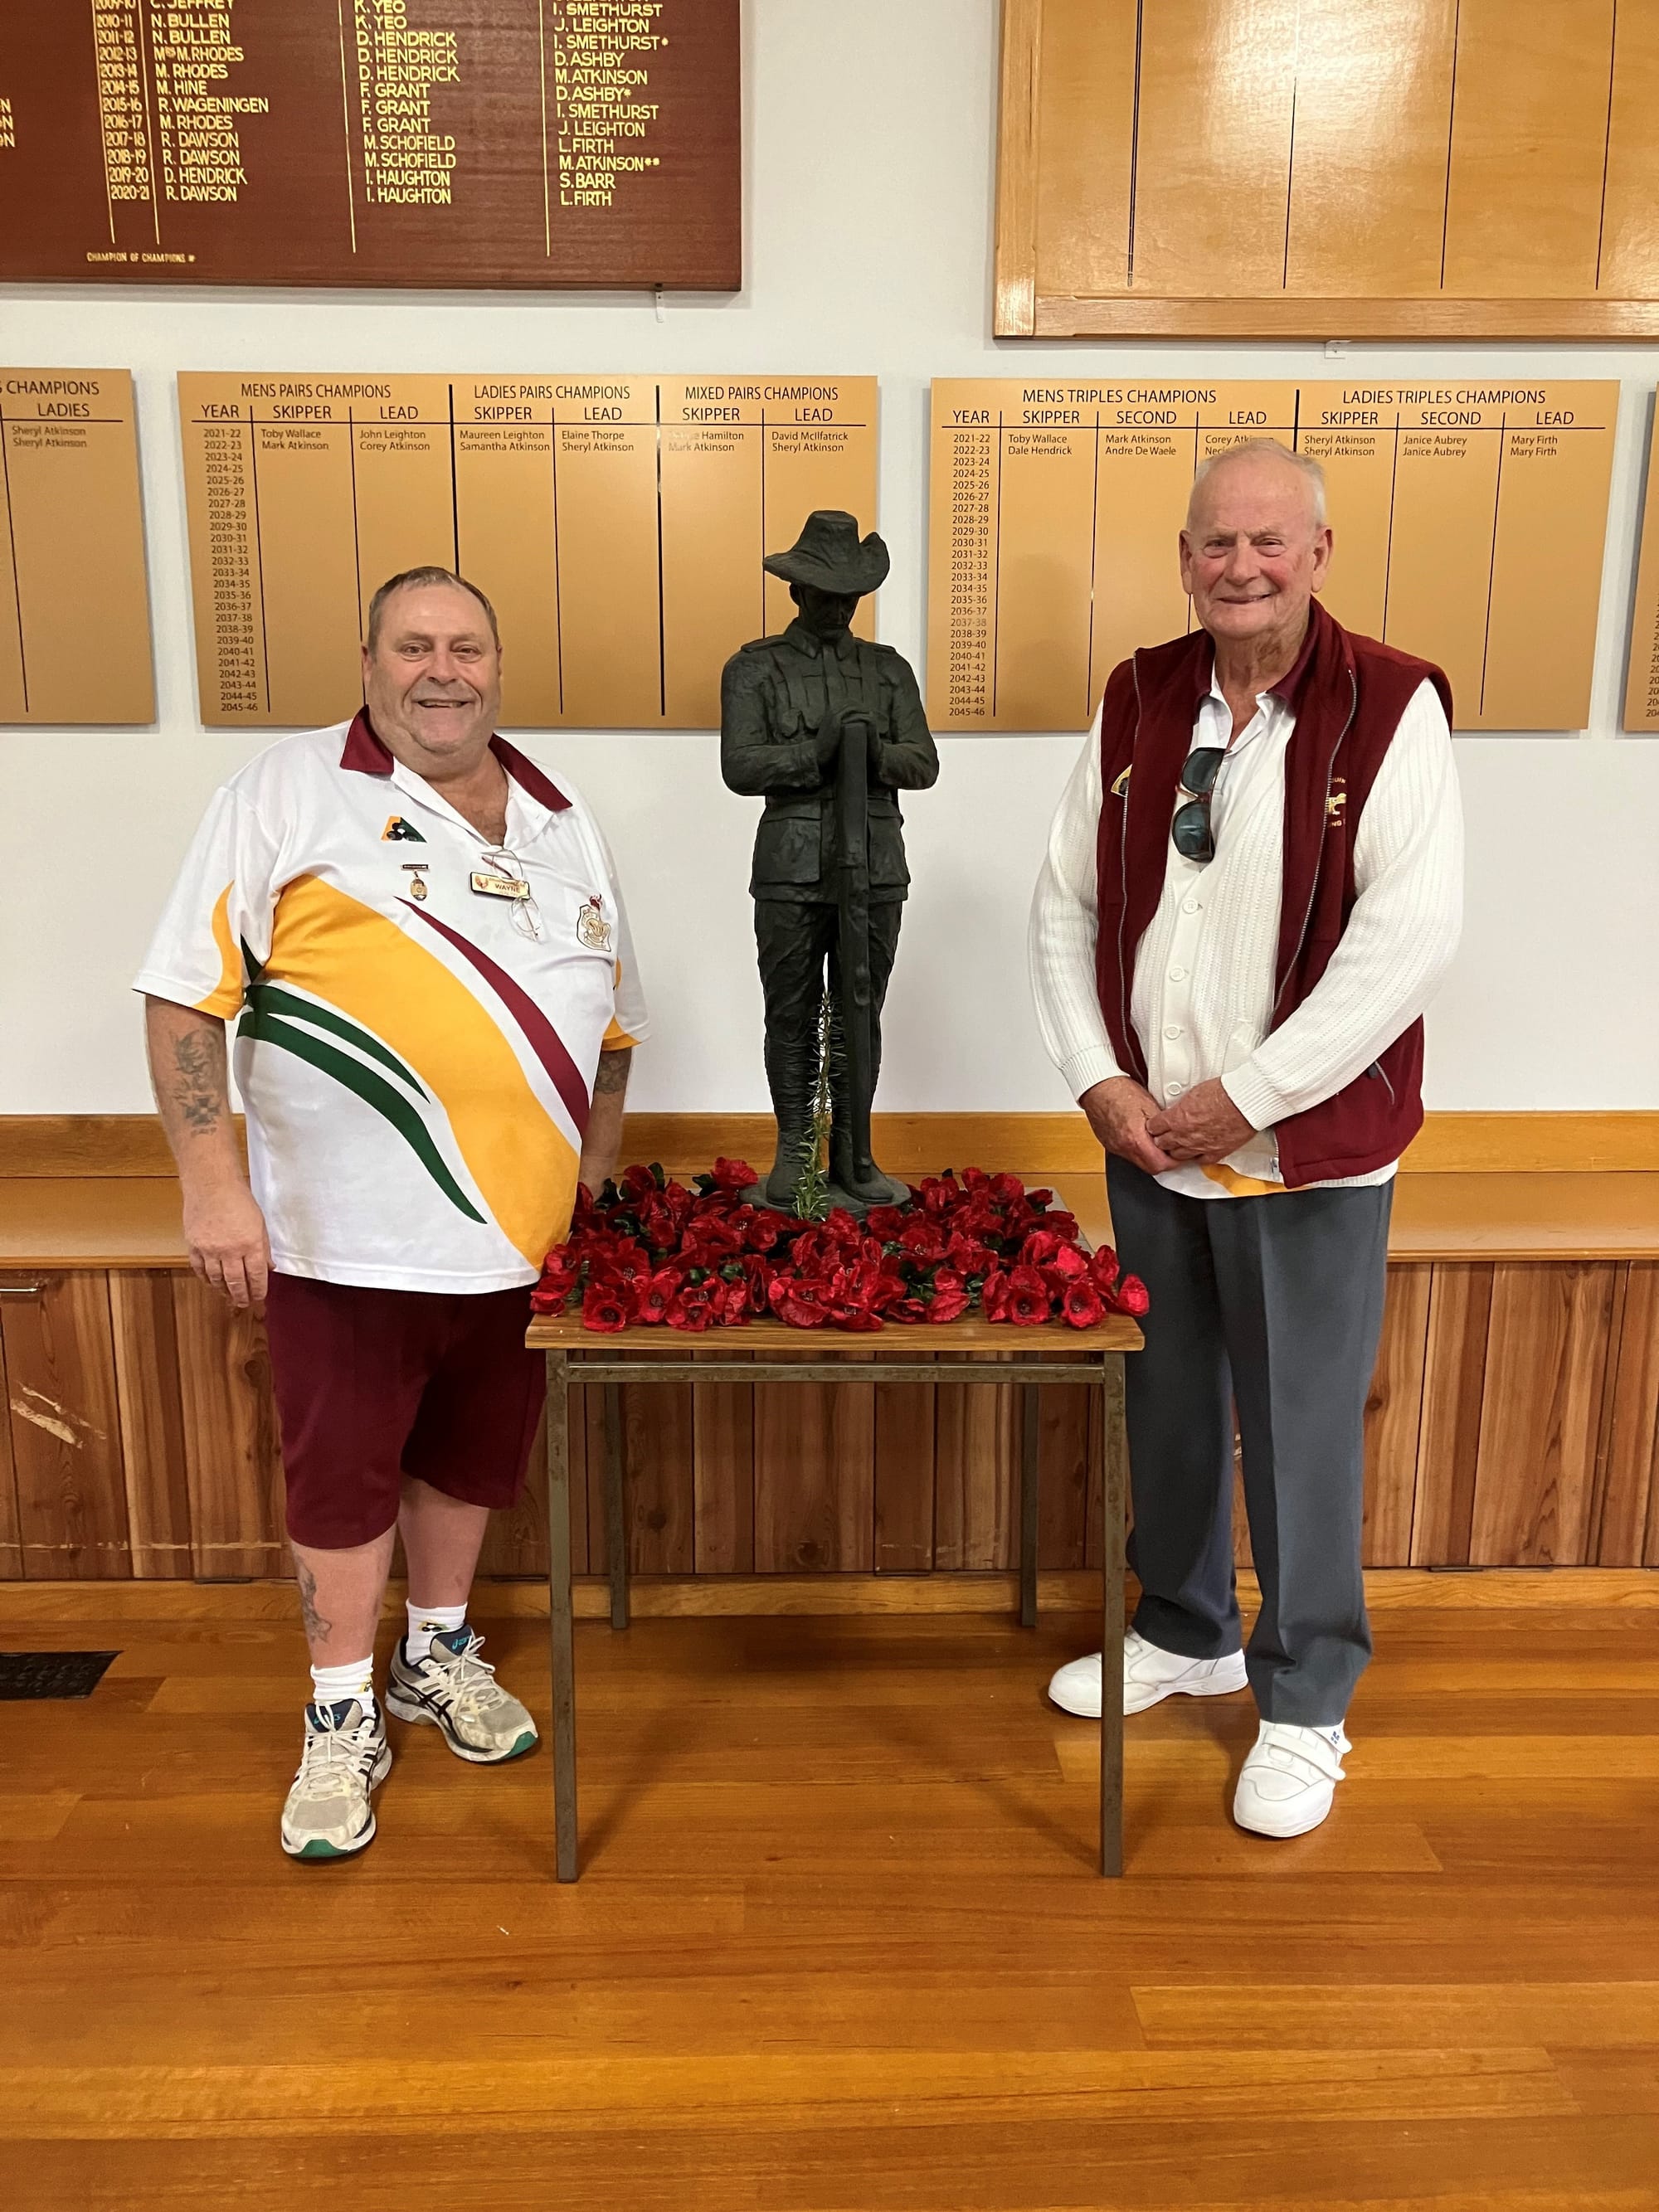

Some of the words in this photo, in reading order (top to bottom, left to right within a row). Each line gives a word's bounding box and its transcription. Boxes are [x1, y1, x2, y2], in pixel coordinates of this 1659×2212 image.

[567, 2, 663, 17] SMETHURST
[373, 15, 406, 29] YEO
[573, 17, 649, 32] LEIGHTON
[376, 48, 458, 64] HENDRICK
[173, 64, 228, 79] RHODES
[377, 66, 460, 81] HENDRICK
[174, 80, 207, 95] HINE
[375, 83, 431, 98] GRANT
[103, 97, 142, 112] 2015-16
[376, 100, 431, 115] GRANT
[569, 104, 659, 119] SMETHURST
[105, 114, 142, 129] 2016-17
[177, 115, 232, 129] RHODES
[377, 118, 431, 133] GRANT
[575, 120, 645, 137] LEIGHTON
[106, 131, 145, 146] 2017-18
[178, 132, 239, 148] DAWSON
[107, 149, 146, 164] 2018-19
[180, 149, 240, 165] DAWSON
[109, 167, 148, 182] 2019-20
[179, 168, 247, 184] HENDRICK
[377, 170, 450, 186] HAUGHTON
[111, 185, 149, 200] 2020-21
[378, 187, 451, 204] HAUGHTON
[87, 252, 127, 261] CHAMPION
[130, 253, 139, 261] OF
[142, 254, 185, 262] CHAMPIONS
[7, 381, 99, 395] CHAMPIONS
[241, 383, 275, 396] MENS
[280, 384, 312, 397] PAIRS
[316, 385, 391, 397] CHAMPIONS
[474, 385, 516, 398] LADIES
[520, 386, 552, 398] PAIRS
[556, 386, 630, 399] CHAMPIONS
[686, 386, 724, 399] MIXED
[729, 387, 761, 400] PAIRS
[765, 387, 838, 400] CHAMPIONS
[1024, 390, 1063, 402] MENS
[1068, 390, 1122, 402] TRIPLES
[1127, 390, 1216, 402] CHAMPIONS
[1344, 391, 1393, 403] LADIES
[1397, 391, 1452, 403] TRIPLES
[1457, 391, 1545, 403] CHAMPIONS
[37, 403, 90, 416] LADIES
[202, 405, 239, 418] YEAR
[274, 406, 331, 418] SKIPPER
[381, 406, 418, 419] LEAD
[474, 406, 532, 420] SKIPPER
[585, 407, 621, 420] LEAD
[683, 408, 739, 421] SKIPPER
[795, 409, 832, 421] LEAD
[953, 411, 989, 423] YEAR
[1023, 411, 1079, 423] SKIPPER
[1117, 411, 1176, 424] SECOND
[1229, 411, 1266, 424] LEAD
[1321, 411, 1378, 425] SKIPPER
[1421, 412, 1481, 425] SECOND
[1537, 411, 1574, 425] LEAD
[12, 425, 41, 437] Sheryl
[45, 426, 85, 435] Atkinson
[204, 429, 241, 438] 2021-22
[261, 429, 283, 440] Toby
[285, 430, 321, 438] Wallace
[360, 430, 377, 438] John
[382, 430, 426, 441] Leighton
[460, 430, 500, 439] Maureen
[504, 431, 544, 441] Leighton
[562, 430, 589, 439] Elaine
[591, 430, 624, 440] Thorpe
[703, 431, 743, 440] Hamilton
[13, 438, 42, 449] Sheryl
[46, 438, 86, 447] Atkinson
[205, 440, 241, 450] 2022-23
[1009, 435, 1030, 445] Toby
[1033, 435, 1067, 443] Wallace
[1106, 435, 1128, 443] Mark
[1131, 435, 1170, 443] Atkinson
[1206, 435, 1232, 445] Corey
[1305, 435, 1332, 445] Sheryl
[1335, 435, 1374, 444] Atkinson
[1434, 435, 1467, 446] Aubrey
[1511, 435, 1535, 446] Mary
[1537, 435, 1557, 444] Firth
[288, 441, 328, 450] Atkinson
[360, 441, 387, 452] Corey
[390, 442, 430, 450] Atkinson
[460, 442, 506, 450] Samantha
[509, 442, 549, 450] Atkinson
[562, 442, 591, 453] Sheryl
[594, 443, 634, 451] Atkinson
[694, 443, 734, 451] Atkinson
[773, 443, 800, 453] Sheryl
[804, 443, 843, 451] Atkinson
[1009, 445, 1029, 455] Dale
[1032, 446, 1072, 455] Hendrick
[1106, 446, 1132, 455] Andre
[1136, 446, 1148, 455] De
[1150, 446, 1176, 455] Waele
[206, 453, 242, 461] 2023-24
[1305, 447, 1331, 457] Sheryl
[1335, 447, 1374, 455] Atkinson
[1433, 448, 1466, 458] Aubrey
[1511, 447, 1533, 458] Mary
[1536, 447, 1556, 455] Firth
[207, 464, 243, 473] 2024-25
[207, 476, 244, 484] 2025-26
[208, 488, 244, 496] 2026-27
[209, 499, 245, 508] 2027-28
[209, 511, 246, 519] 2028-29
[210, 523, 246, 531] 2029-30
[211, 534, 246, 542] 2030-31
[212, 545, 247, 554] 2031-32
[212, 557, 248, 565] 2032-33
[951, 596, 986, 604] 2035-36
[951, 607, 986, 615] 2036-37
[951, 630, 986, 638] 2038-39
[951, 652, 985, 660] 2040-41
[950, 674, 985, 683] 2042-43
[950, 707, 985, 716] 2045-46
[495, 884, 519, 892] WAYNE
